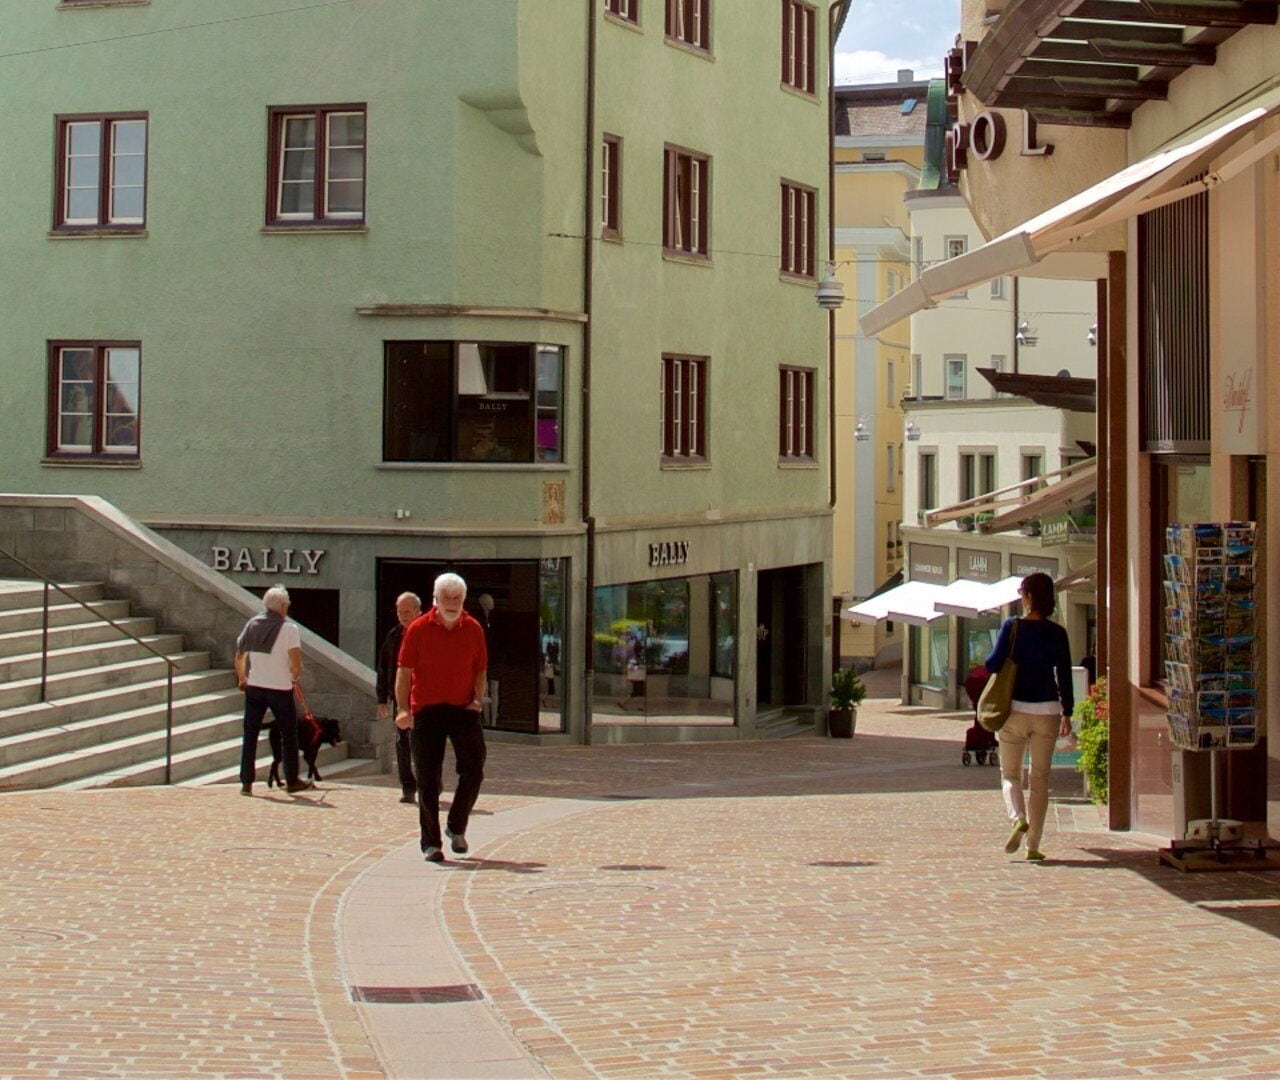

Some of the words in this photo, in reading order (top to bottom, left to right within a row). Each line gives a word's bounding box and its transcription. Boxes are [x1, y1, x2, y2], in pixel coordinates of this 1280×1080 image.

[1042, 521, 1068, 536] LAMM
[211, 545, 326, 575] BALLY
[649, 540, 692, 568] BALLY
